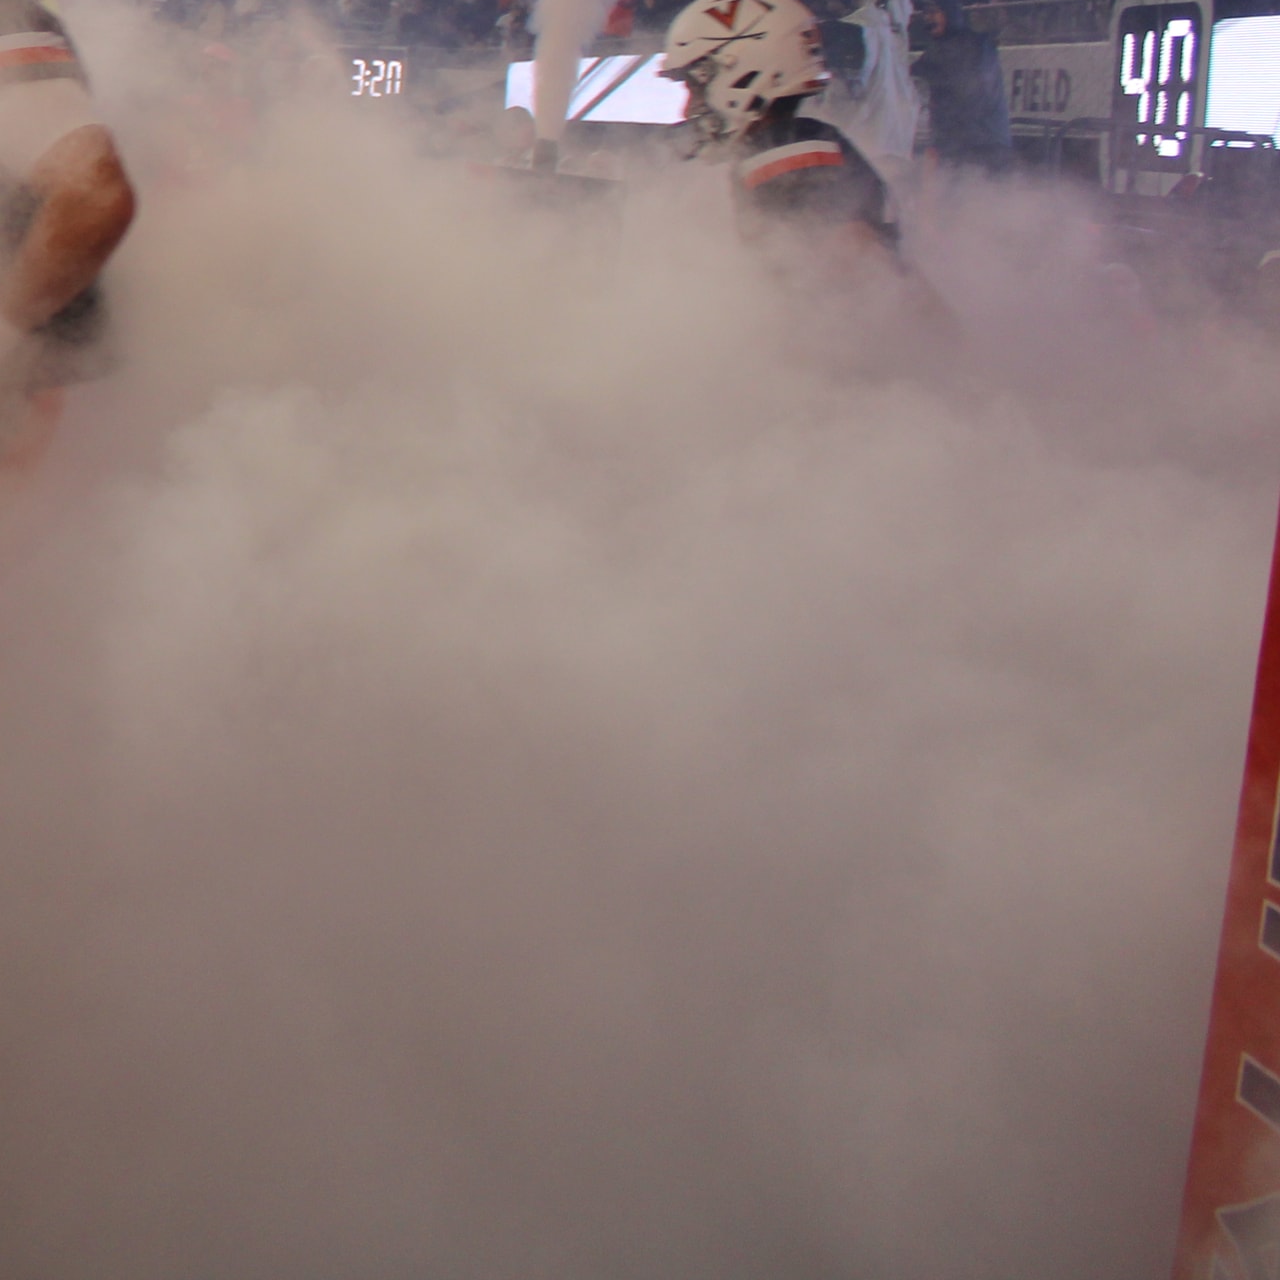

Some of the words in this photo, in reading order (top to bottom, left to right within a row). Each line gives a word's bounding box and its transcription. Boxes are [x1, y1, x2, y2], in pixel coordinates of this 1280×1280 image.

[351, 58, 403, 97] 3:20
[1011, 67, 1072, 113] FIELD
[1120, 18, 1195, 158] 40
